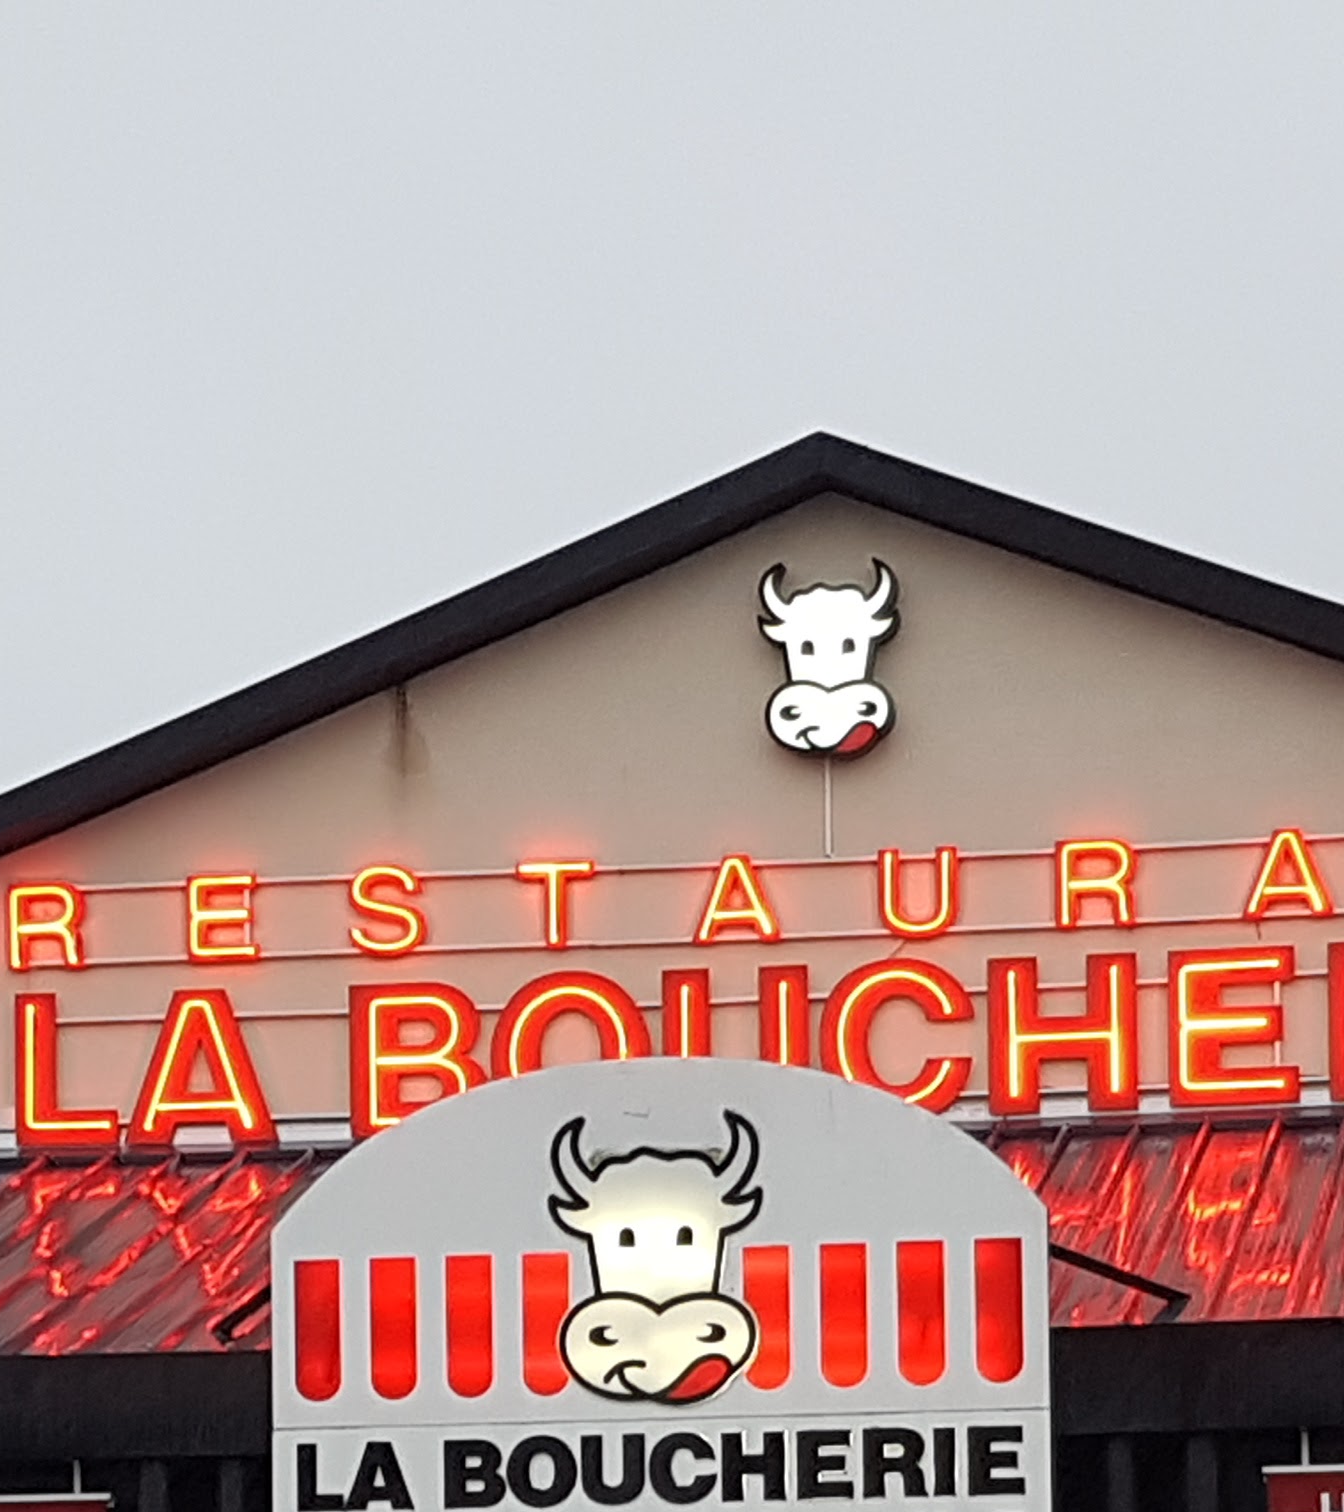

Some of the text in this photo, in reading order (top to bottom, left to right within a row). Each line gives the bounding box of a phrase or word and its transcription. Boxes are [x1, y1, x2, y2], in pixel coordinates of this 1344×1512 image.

[15, 990, 279, 1147] LA
[297, 1425, 1026, 1512] LA BOUCHERIE
